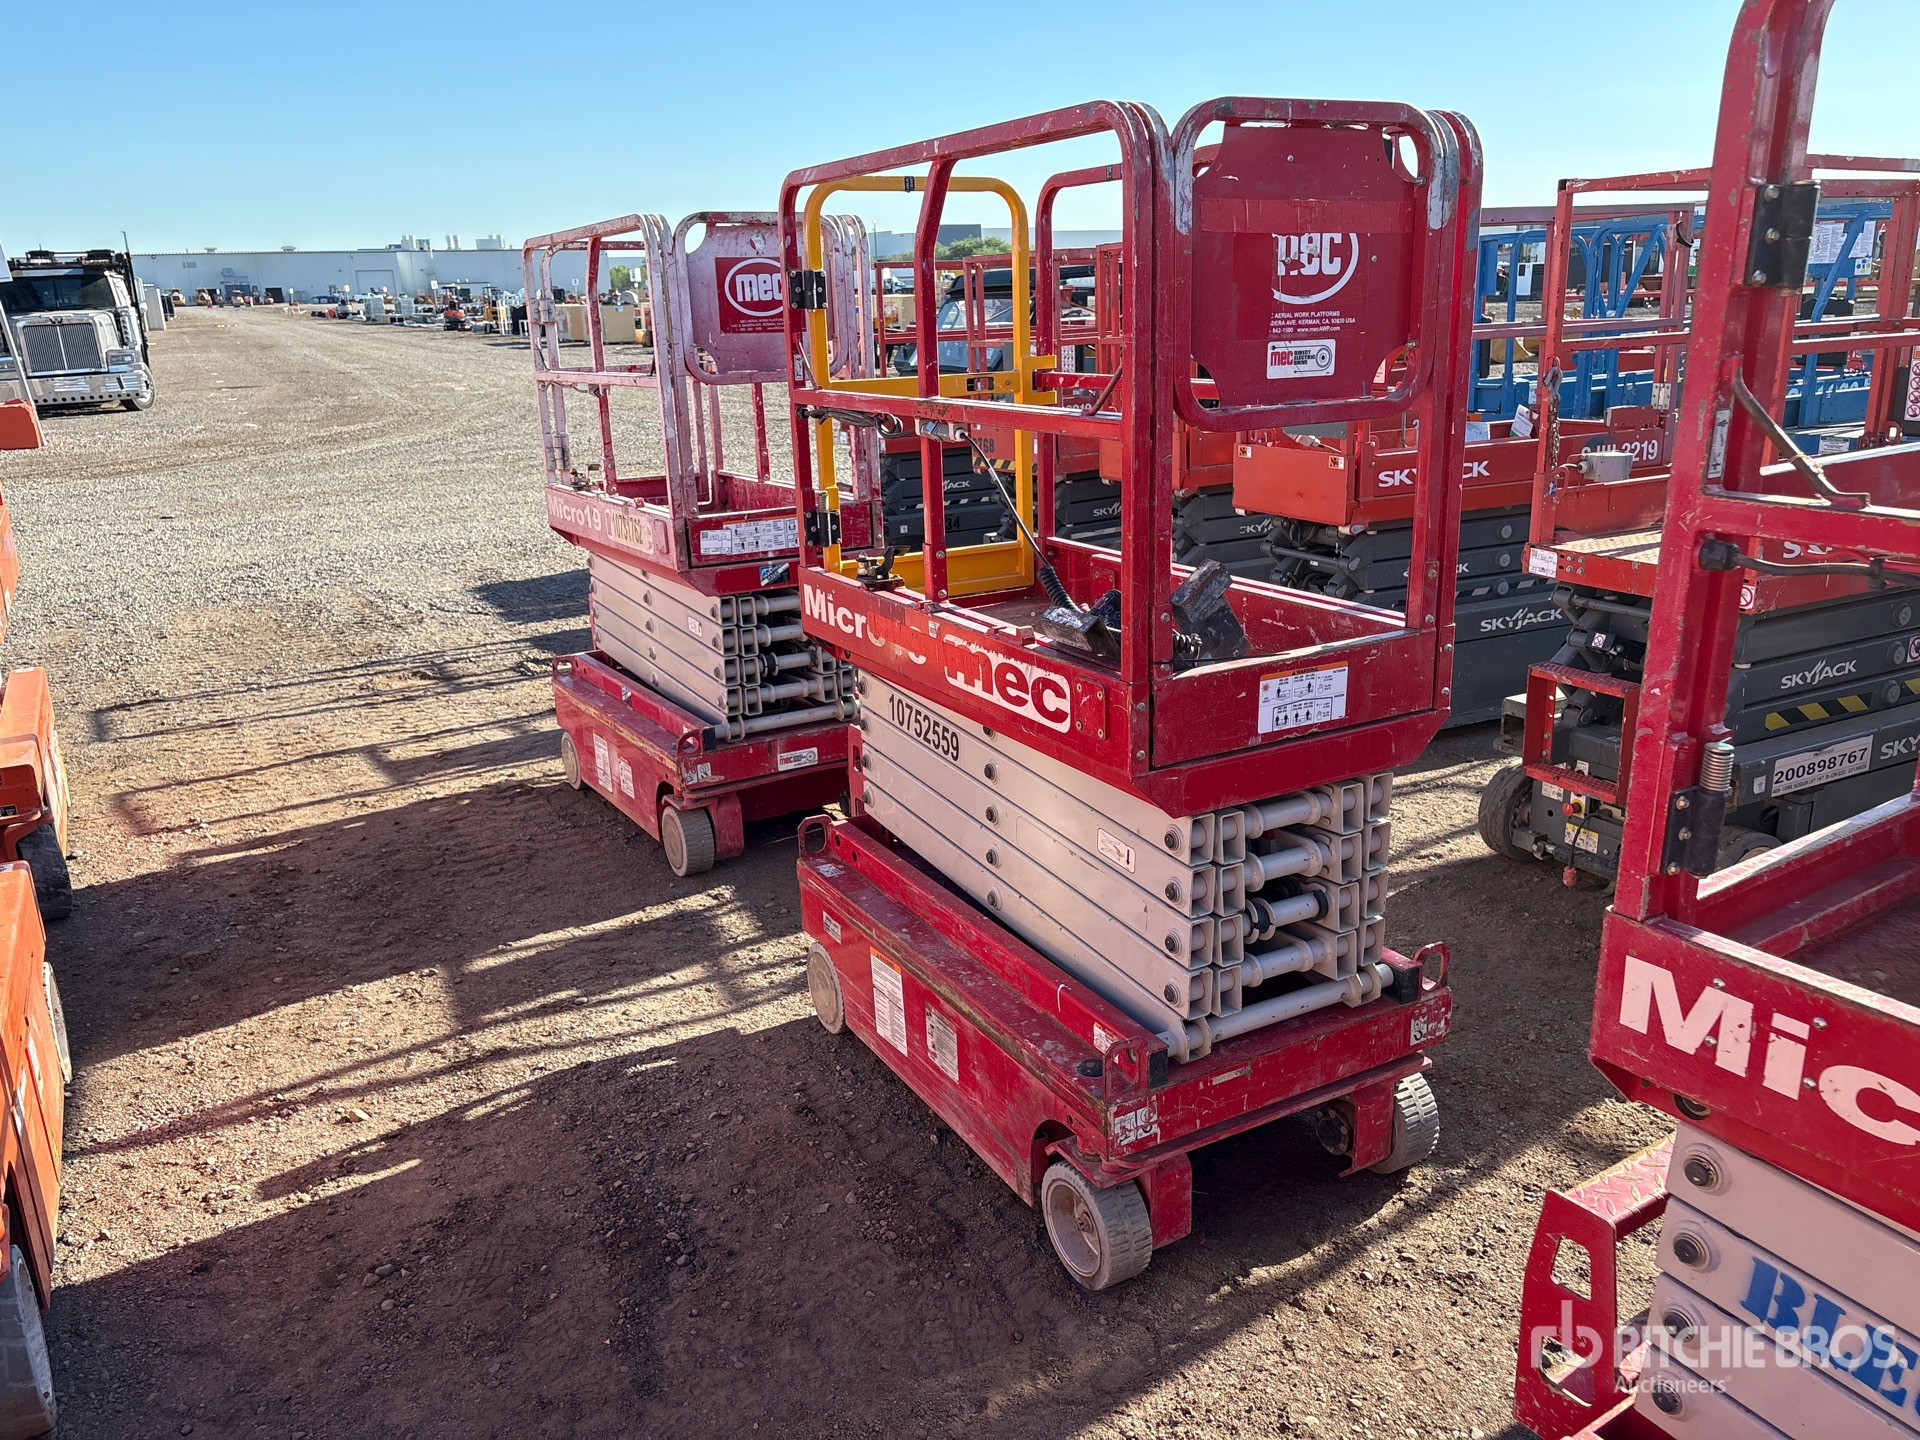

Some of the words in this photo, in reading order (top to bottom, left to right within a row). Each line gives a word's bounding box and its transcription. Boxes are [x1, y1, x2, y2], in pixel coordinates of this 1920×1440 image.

[1270, 350, 1294, 367] mec
[548, 494, 602, 532] Micro19
[1480, 607, 1563, 633] SKYJACK
[1780, 659, 1857, 690] SKYJACK
[888, 694, 960, 762] 10752559
[1774, 747, 1868, 785] 200898767
